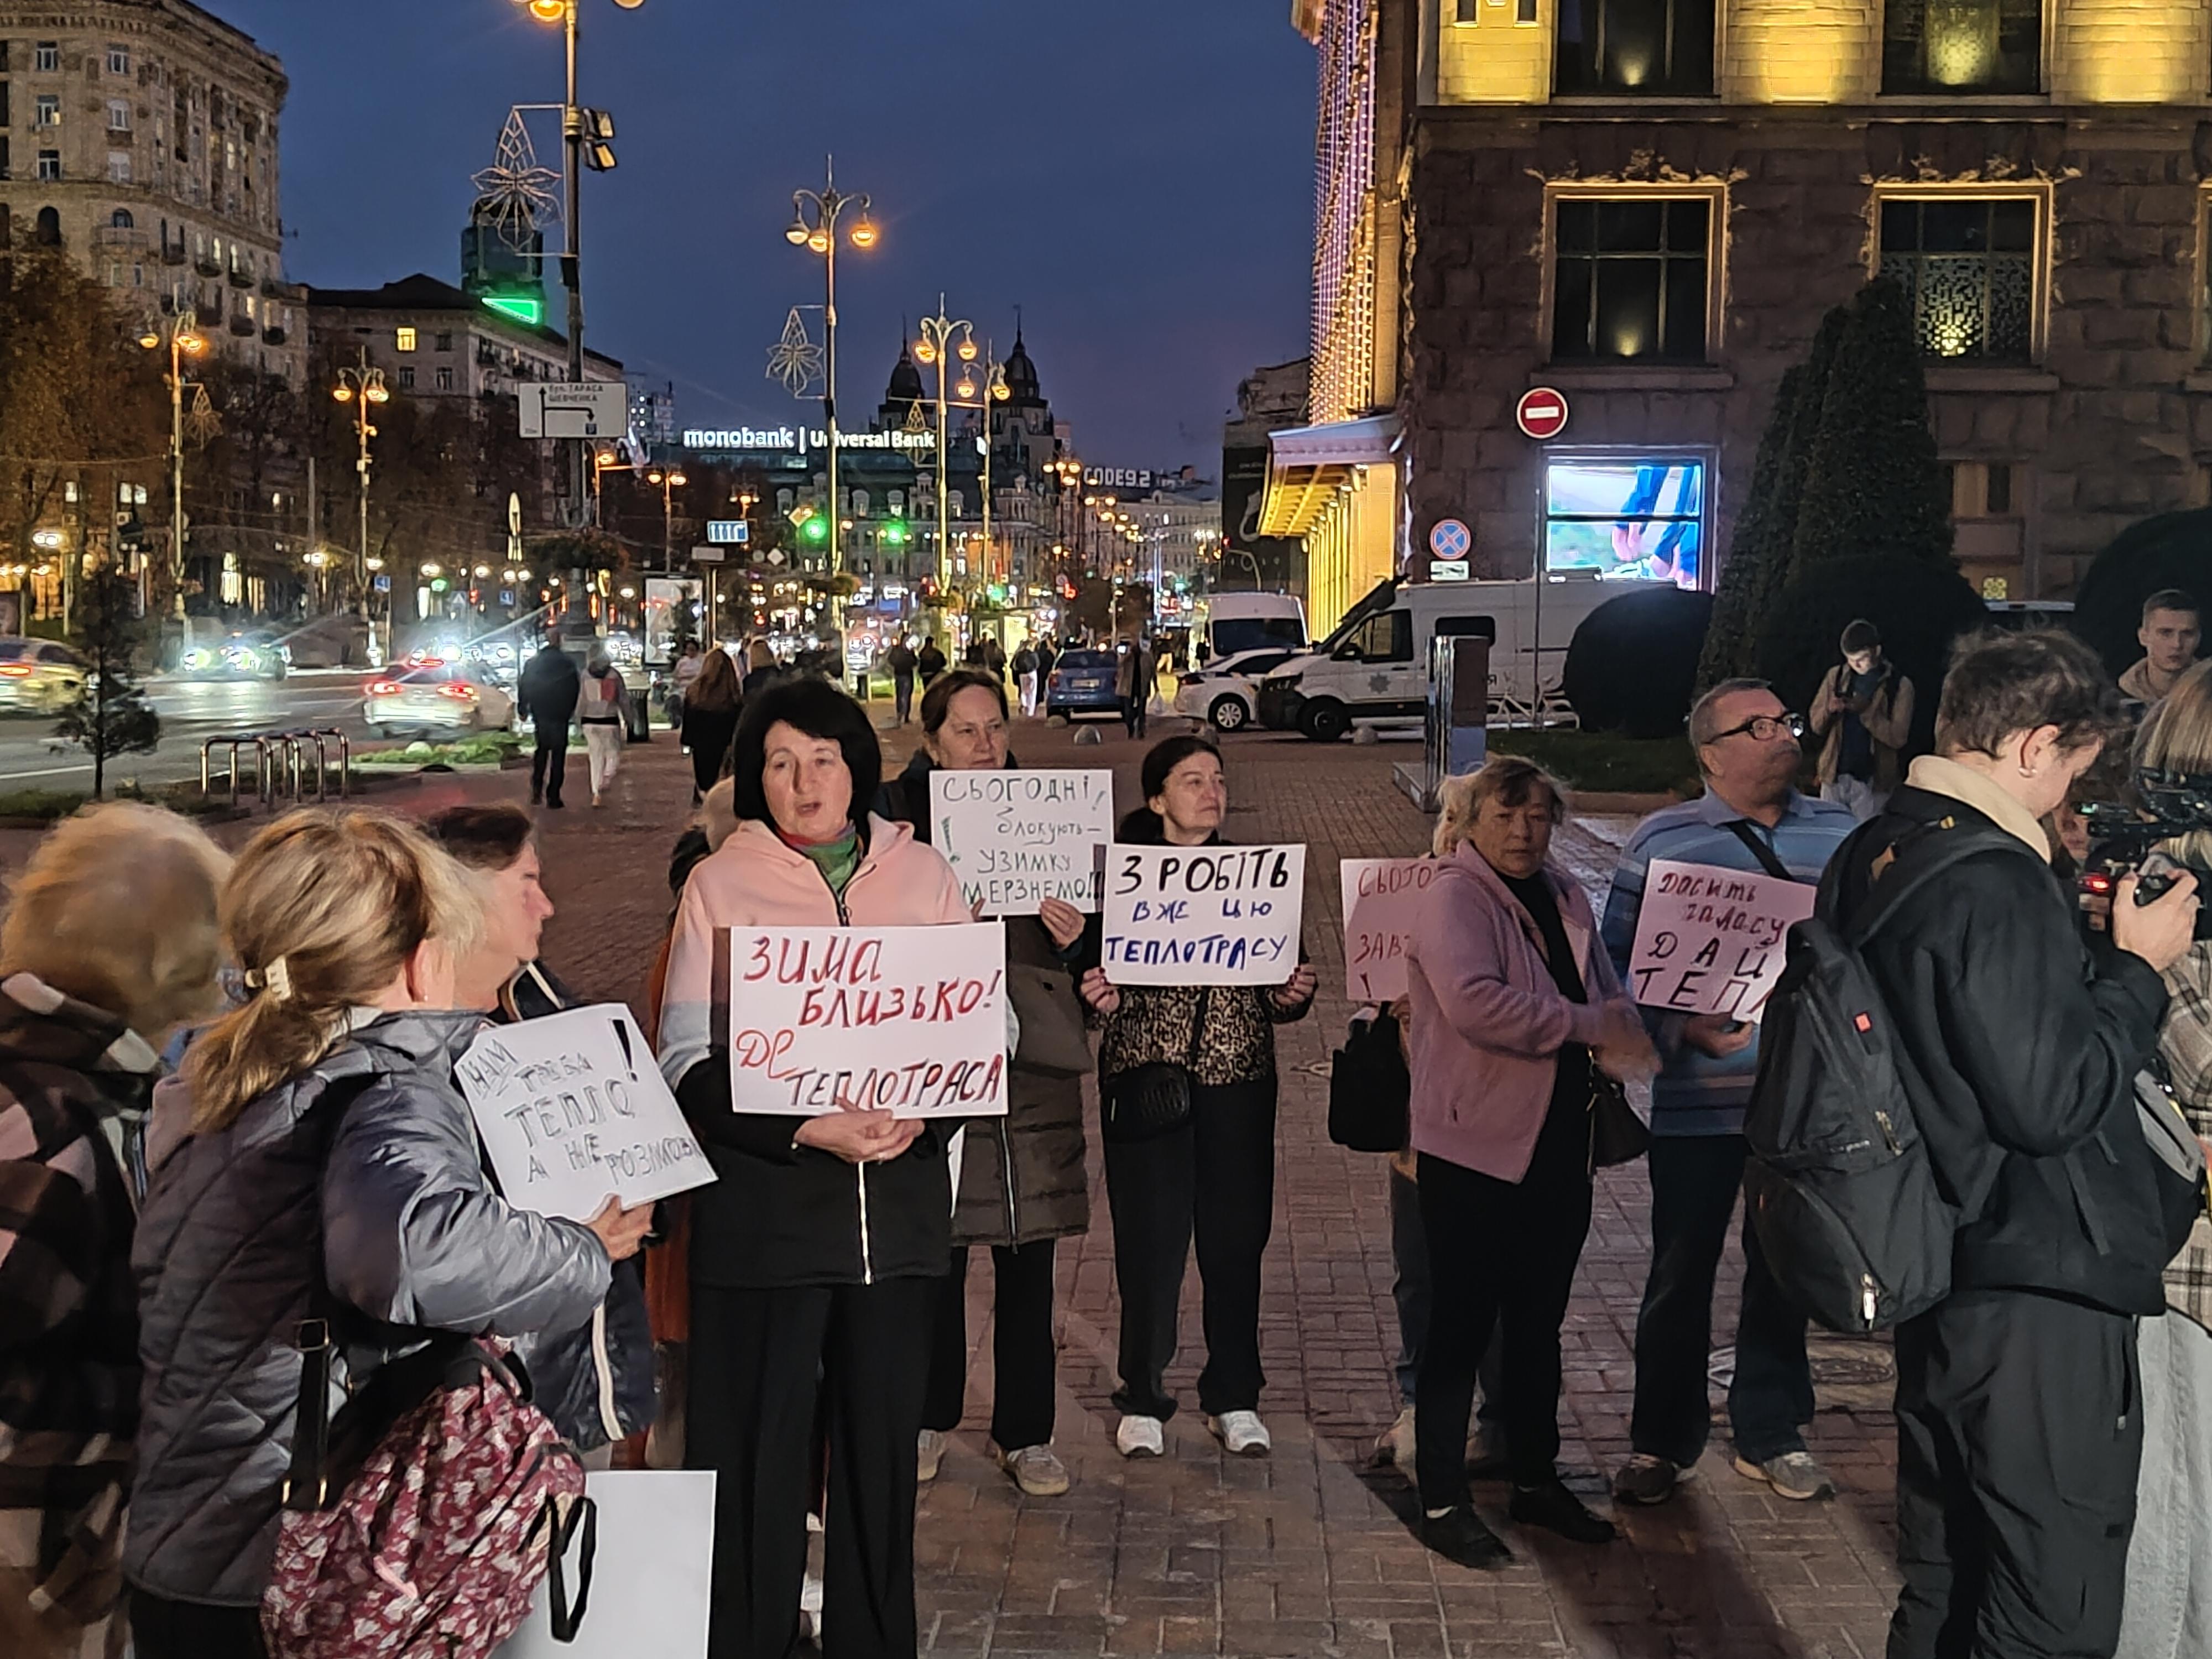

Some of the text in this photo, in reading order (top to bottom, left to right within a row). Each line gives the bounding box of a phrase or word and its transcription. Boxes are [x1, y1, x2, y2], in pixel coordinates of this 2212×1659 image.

[684, 427, 795, 447] monobank
[891, 430, 936, 448] Bank
[978, 848, 1071, 874] УЗИМКУ
[1105, 935, 1287, 970] ТЕПЛОТРАСУ
[785, 1053, 1004, 1109] ТЕПЛОТРАСА
